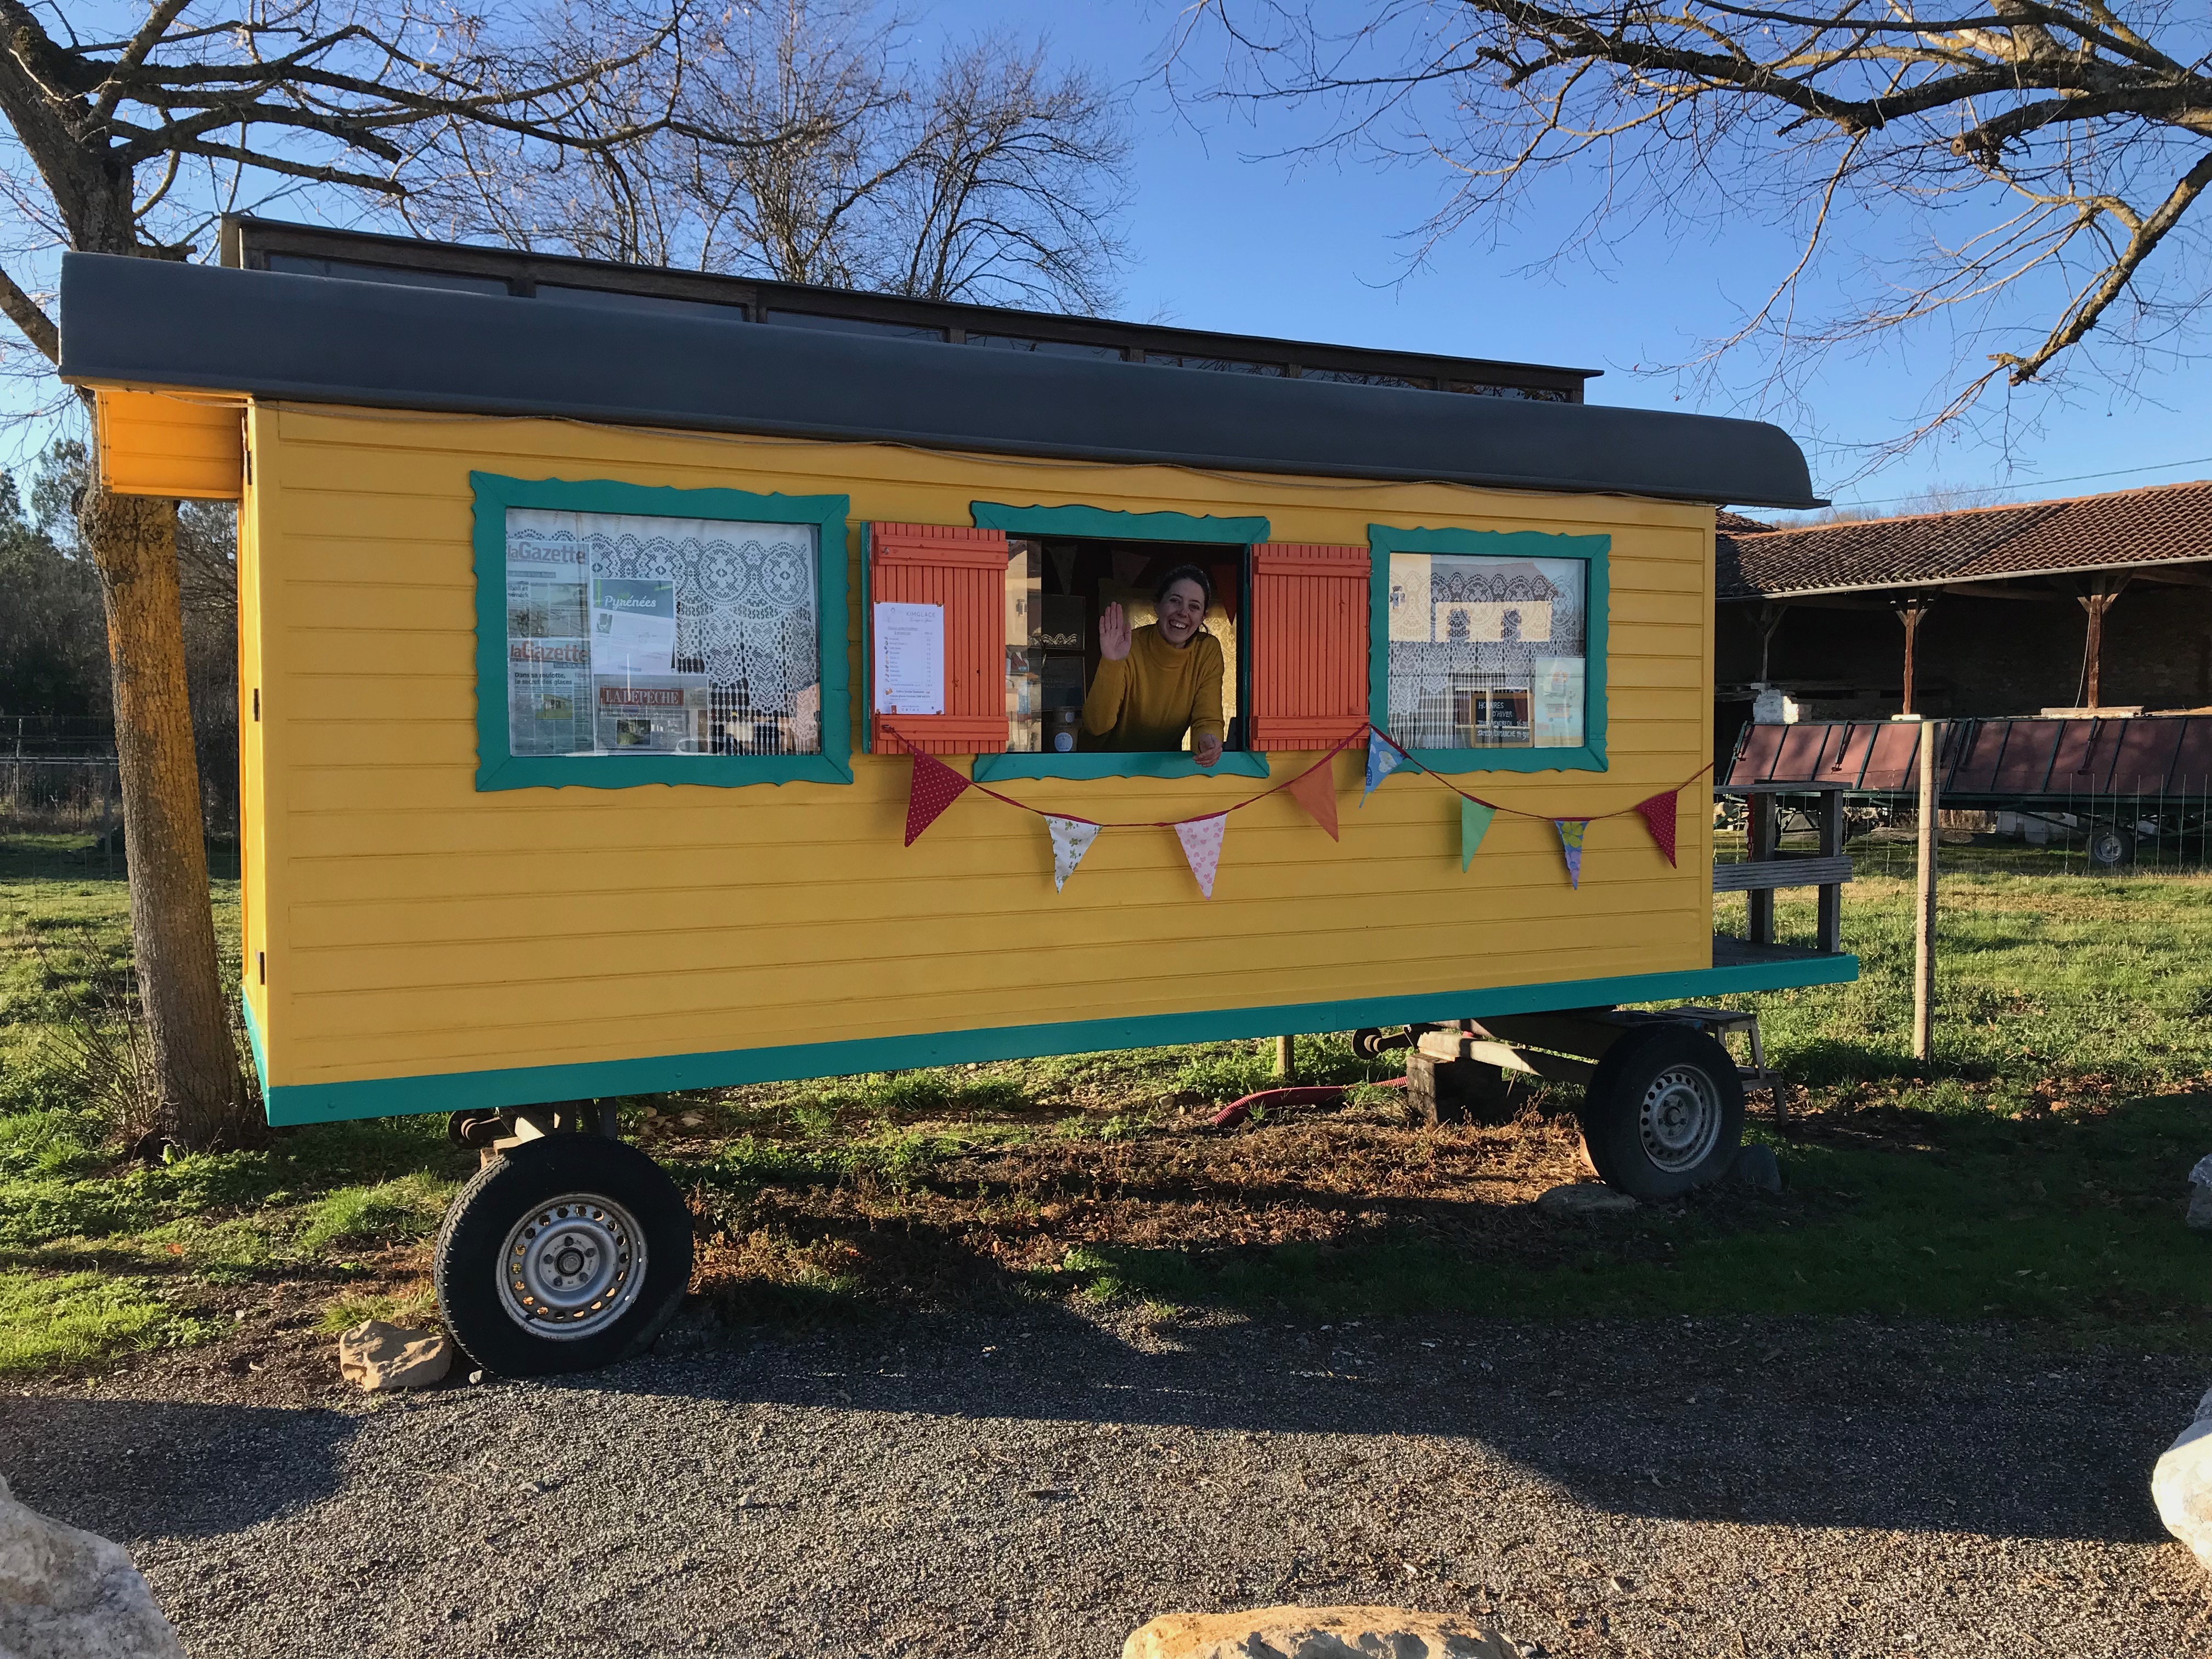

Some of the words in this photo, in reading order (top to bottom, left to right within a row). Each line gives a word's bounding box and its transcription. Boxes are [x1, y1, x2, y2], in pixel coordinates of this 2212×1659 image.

[507, 541, 585, 565] laGazette
[604, 595, 657, 610] Pyrénées
[510, 640, 589, 662] laGazette
[606, 690, 622, 703] LA
[1479, 701, 1504, 709] HORAIRES
